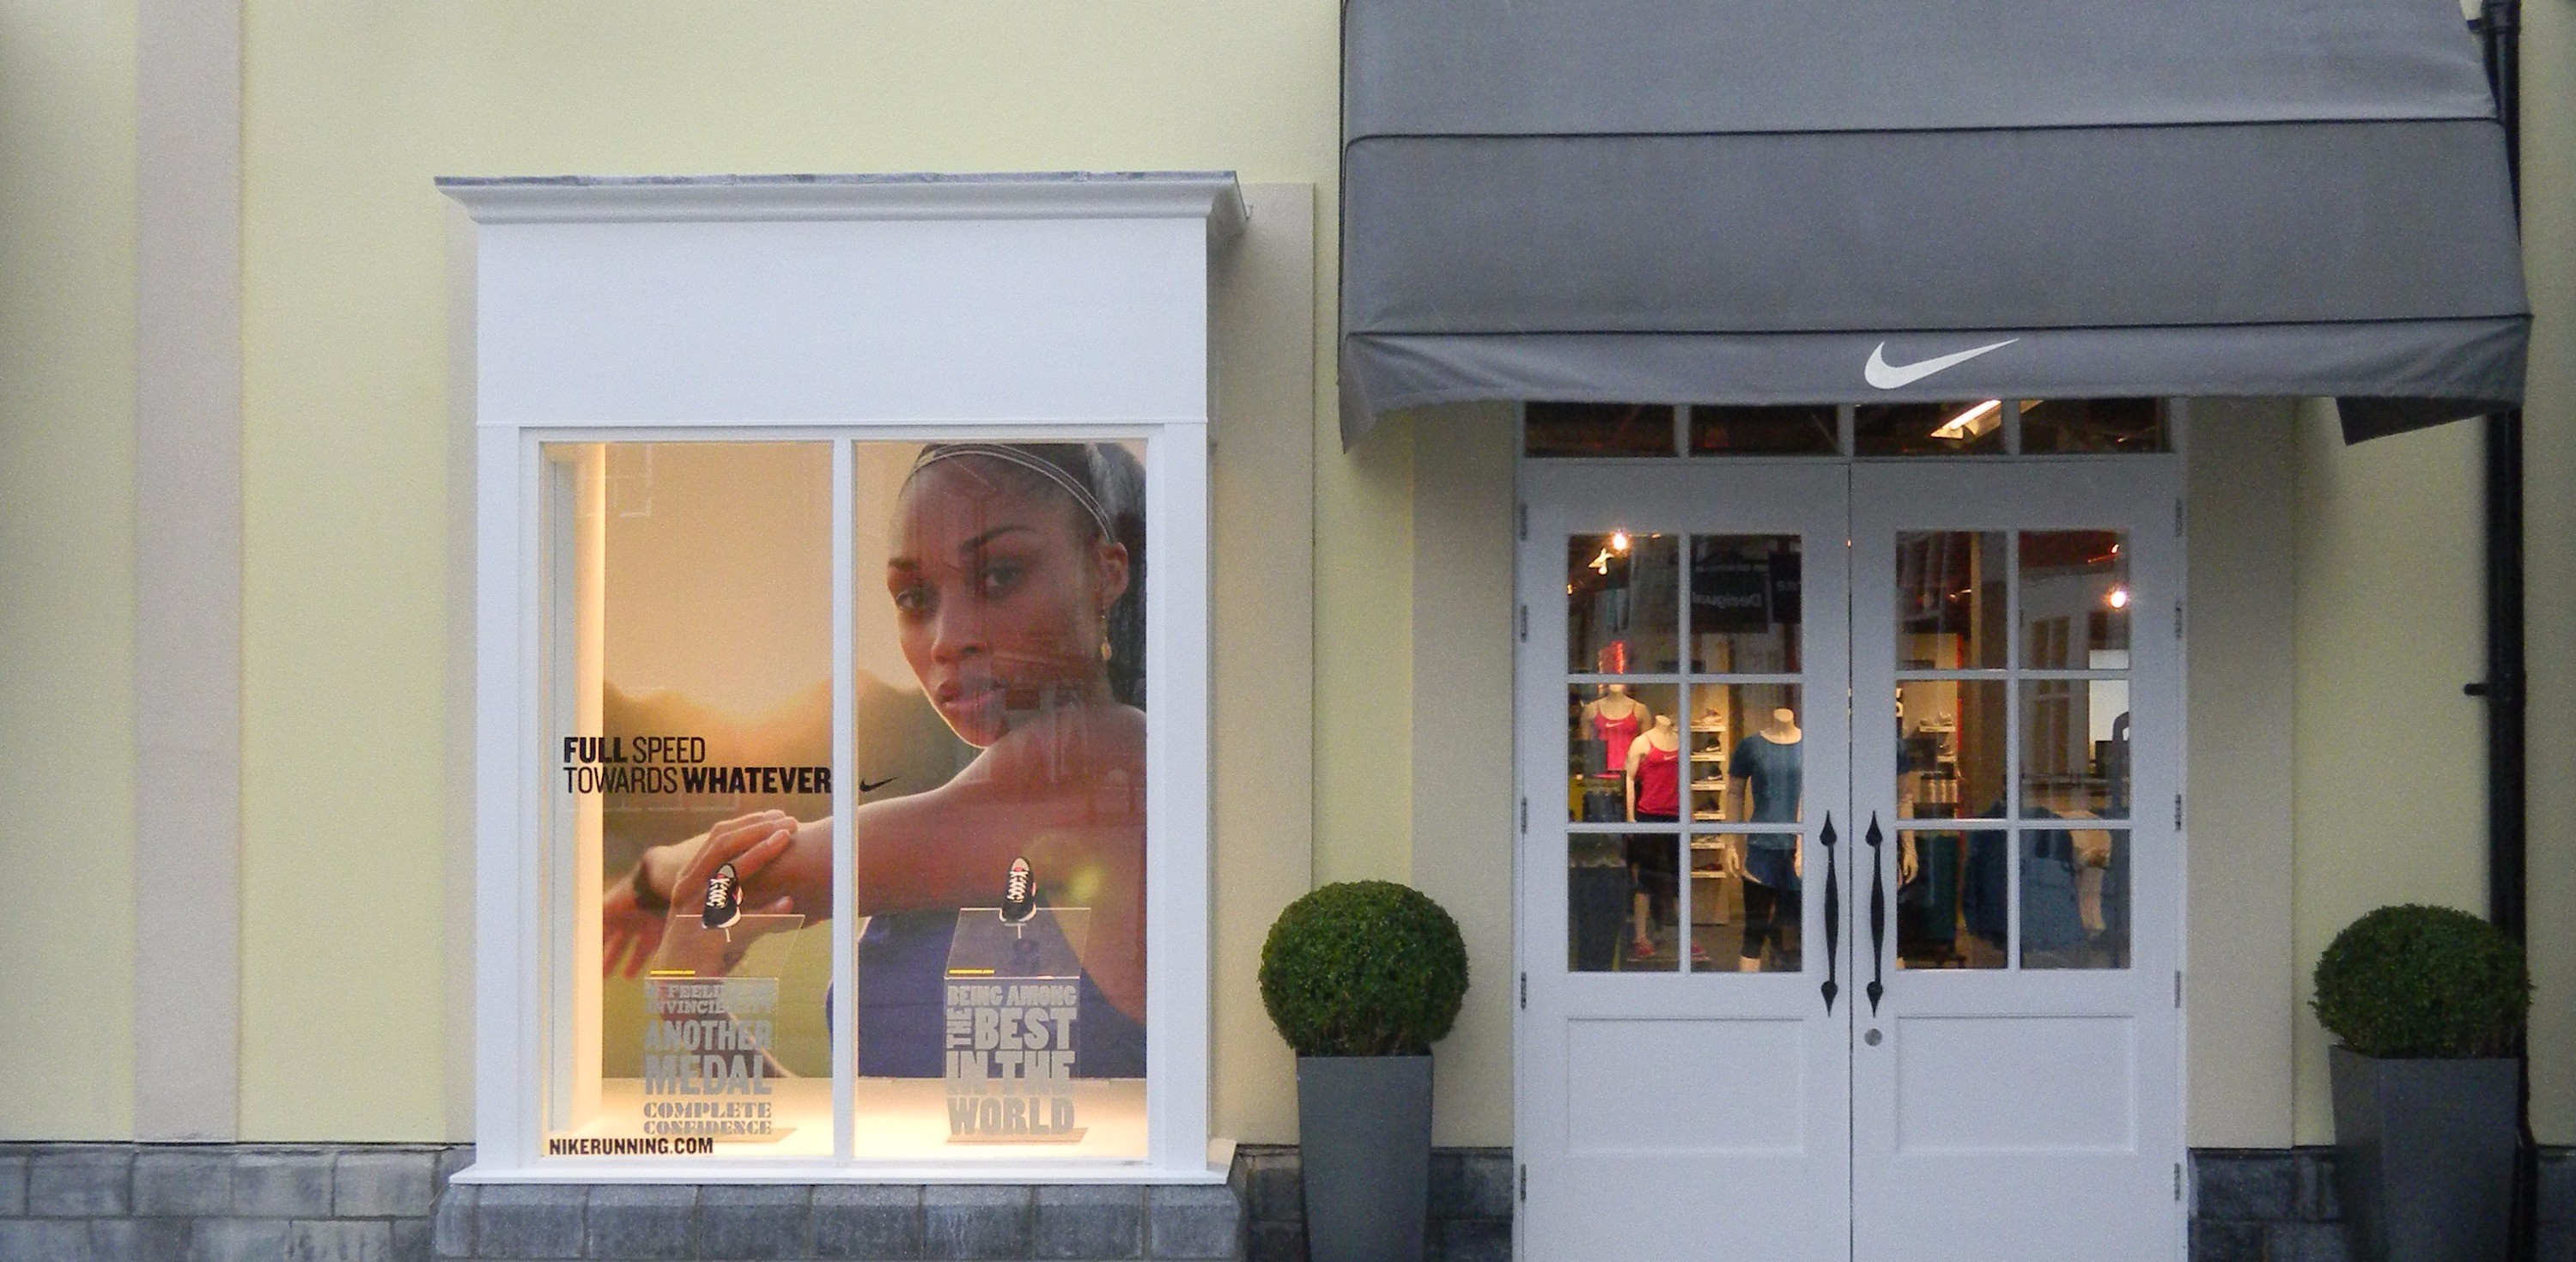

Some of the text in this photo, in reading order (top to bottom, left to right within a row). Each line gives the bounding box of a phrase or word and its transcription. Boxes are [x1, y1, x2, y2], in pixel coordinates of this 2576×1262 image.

[563, 737, 706, 763] FULL SPEED
[563, 767, 832, 794] TOWARDS WHATEVER
[947, 986, 1078, 1006] BEING AMONG
[644, 1020, 771, 1052] ANOTHER
[946, 1007, 1078, 1050] THE BEST
[644, 1055, 772, 1096] MEDAL
[945, 1050, 1076, 1095] IN THE
[643, 1102, 772, 1119] COMPLETE
[947, 1096, 1075, 1136] WORLD
[643, 1120, 772, 1136] CONFIDENCE
[550, 1138, 714, 1156] NIKERUNNING.COM
